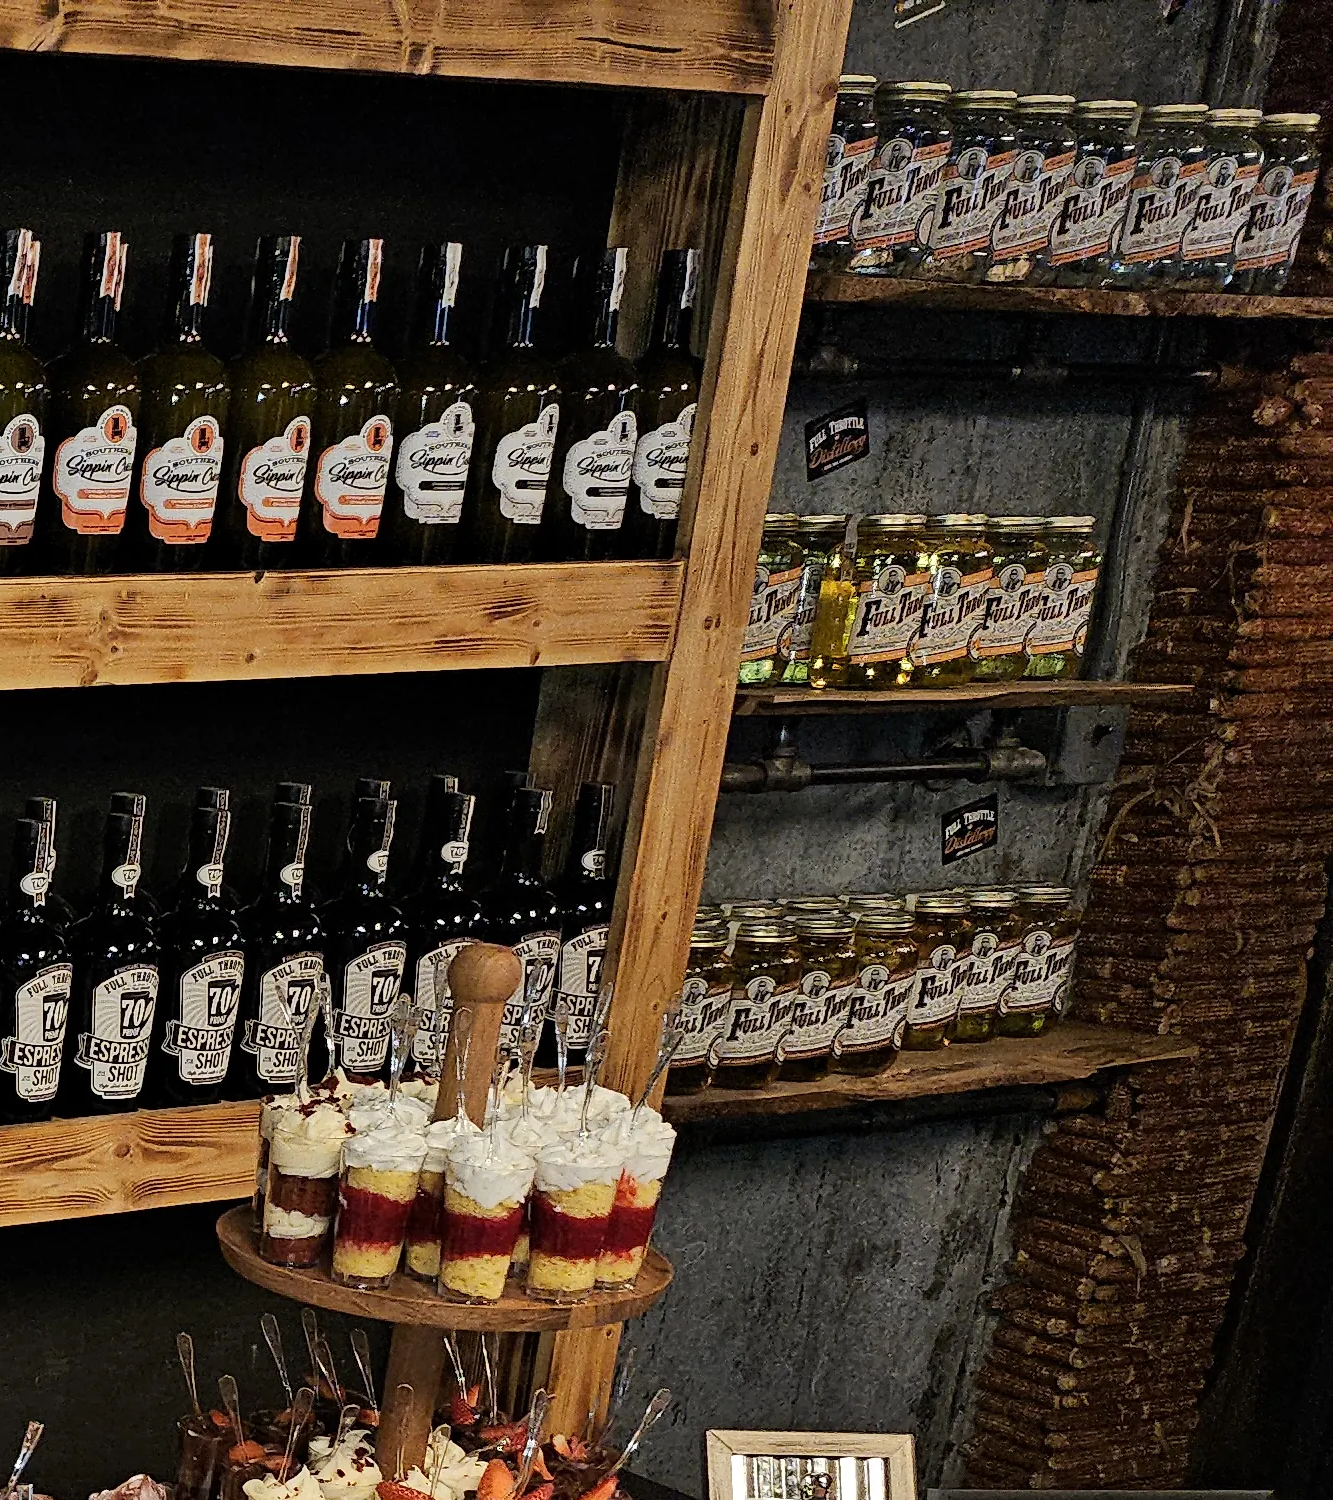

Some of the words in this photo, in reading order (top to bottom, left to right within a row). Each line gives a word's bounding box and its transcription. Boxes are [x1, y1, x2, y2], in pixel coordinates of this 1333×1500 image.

[860, 177, 900, 221] FULL
[941, 186, 979, 229] FULL
[1057, 192, 1097, 236] FULL
[1135, 194, 1169, 234] FULL
[809, 435, 867, 468] Distillery
[859, 600, 895, 636] FULL
[920, 599, 956, 638] FULL
[944, 825, 996, 854] Distillery
[945, 818, 961, 840] FULL
[963, 809, 996, 825] THROTTLE
[1013, 958, 1044, 990] FULL
[915, 977, 948, 1009] FULL
[727, 1007, 764, 1041] FULL
[847, 996, 880, 1030] FULL
